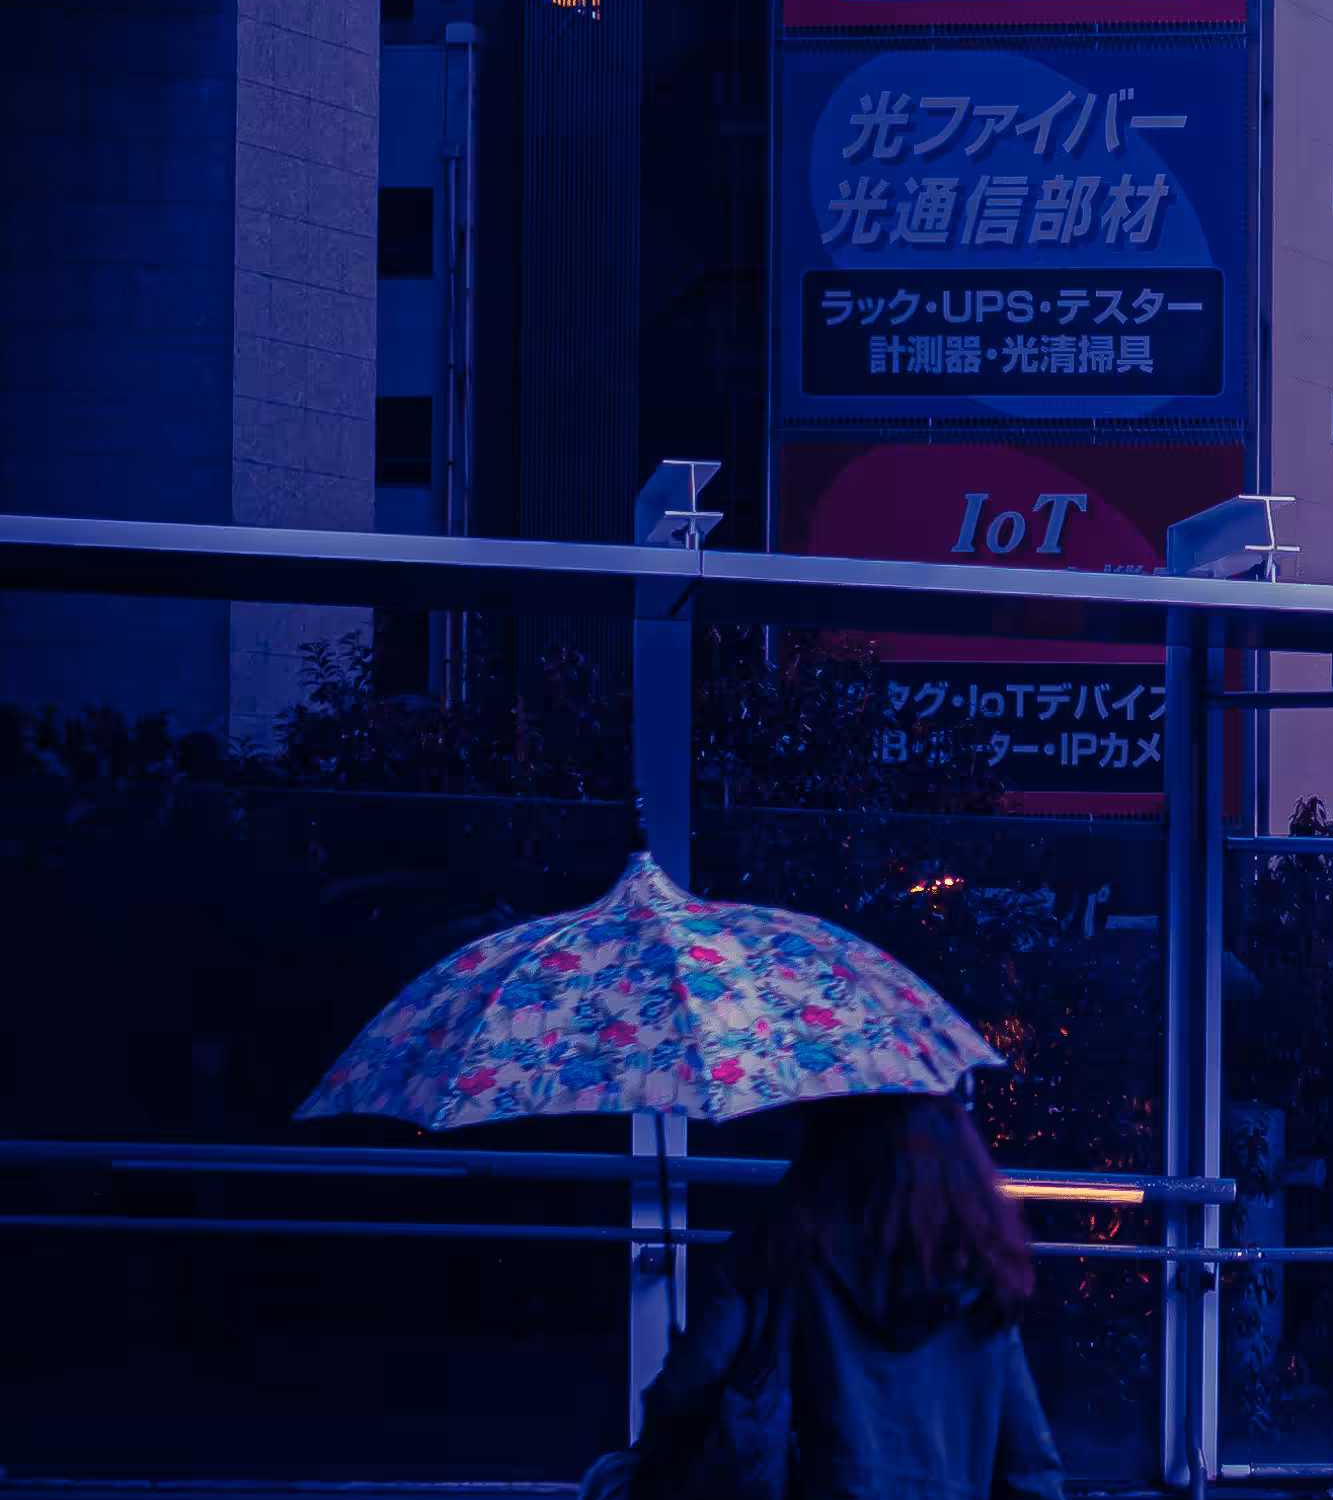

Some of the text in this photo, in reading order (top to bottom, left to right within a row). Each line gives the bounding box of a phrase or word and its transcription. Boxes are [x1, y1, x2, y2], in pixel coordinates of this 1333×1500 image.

[843, 86, 1187, 160] 光ファイバー
[821, 172, 1169, 249] 光通信部材
[820, 289, 1203, 325] ラック・UPS・テスター
[951, 492, 1087, 554] IoT
